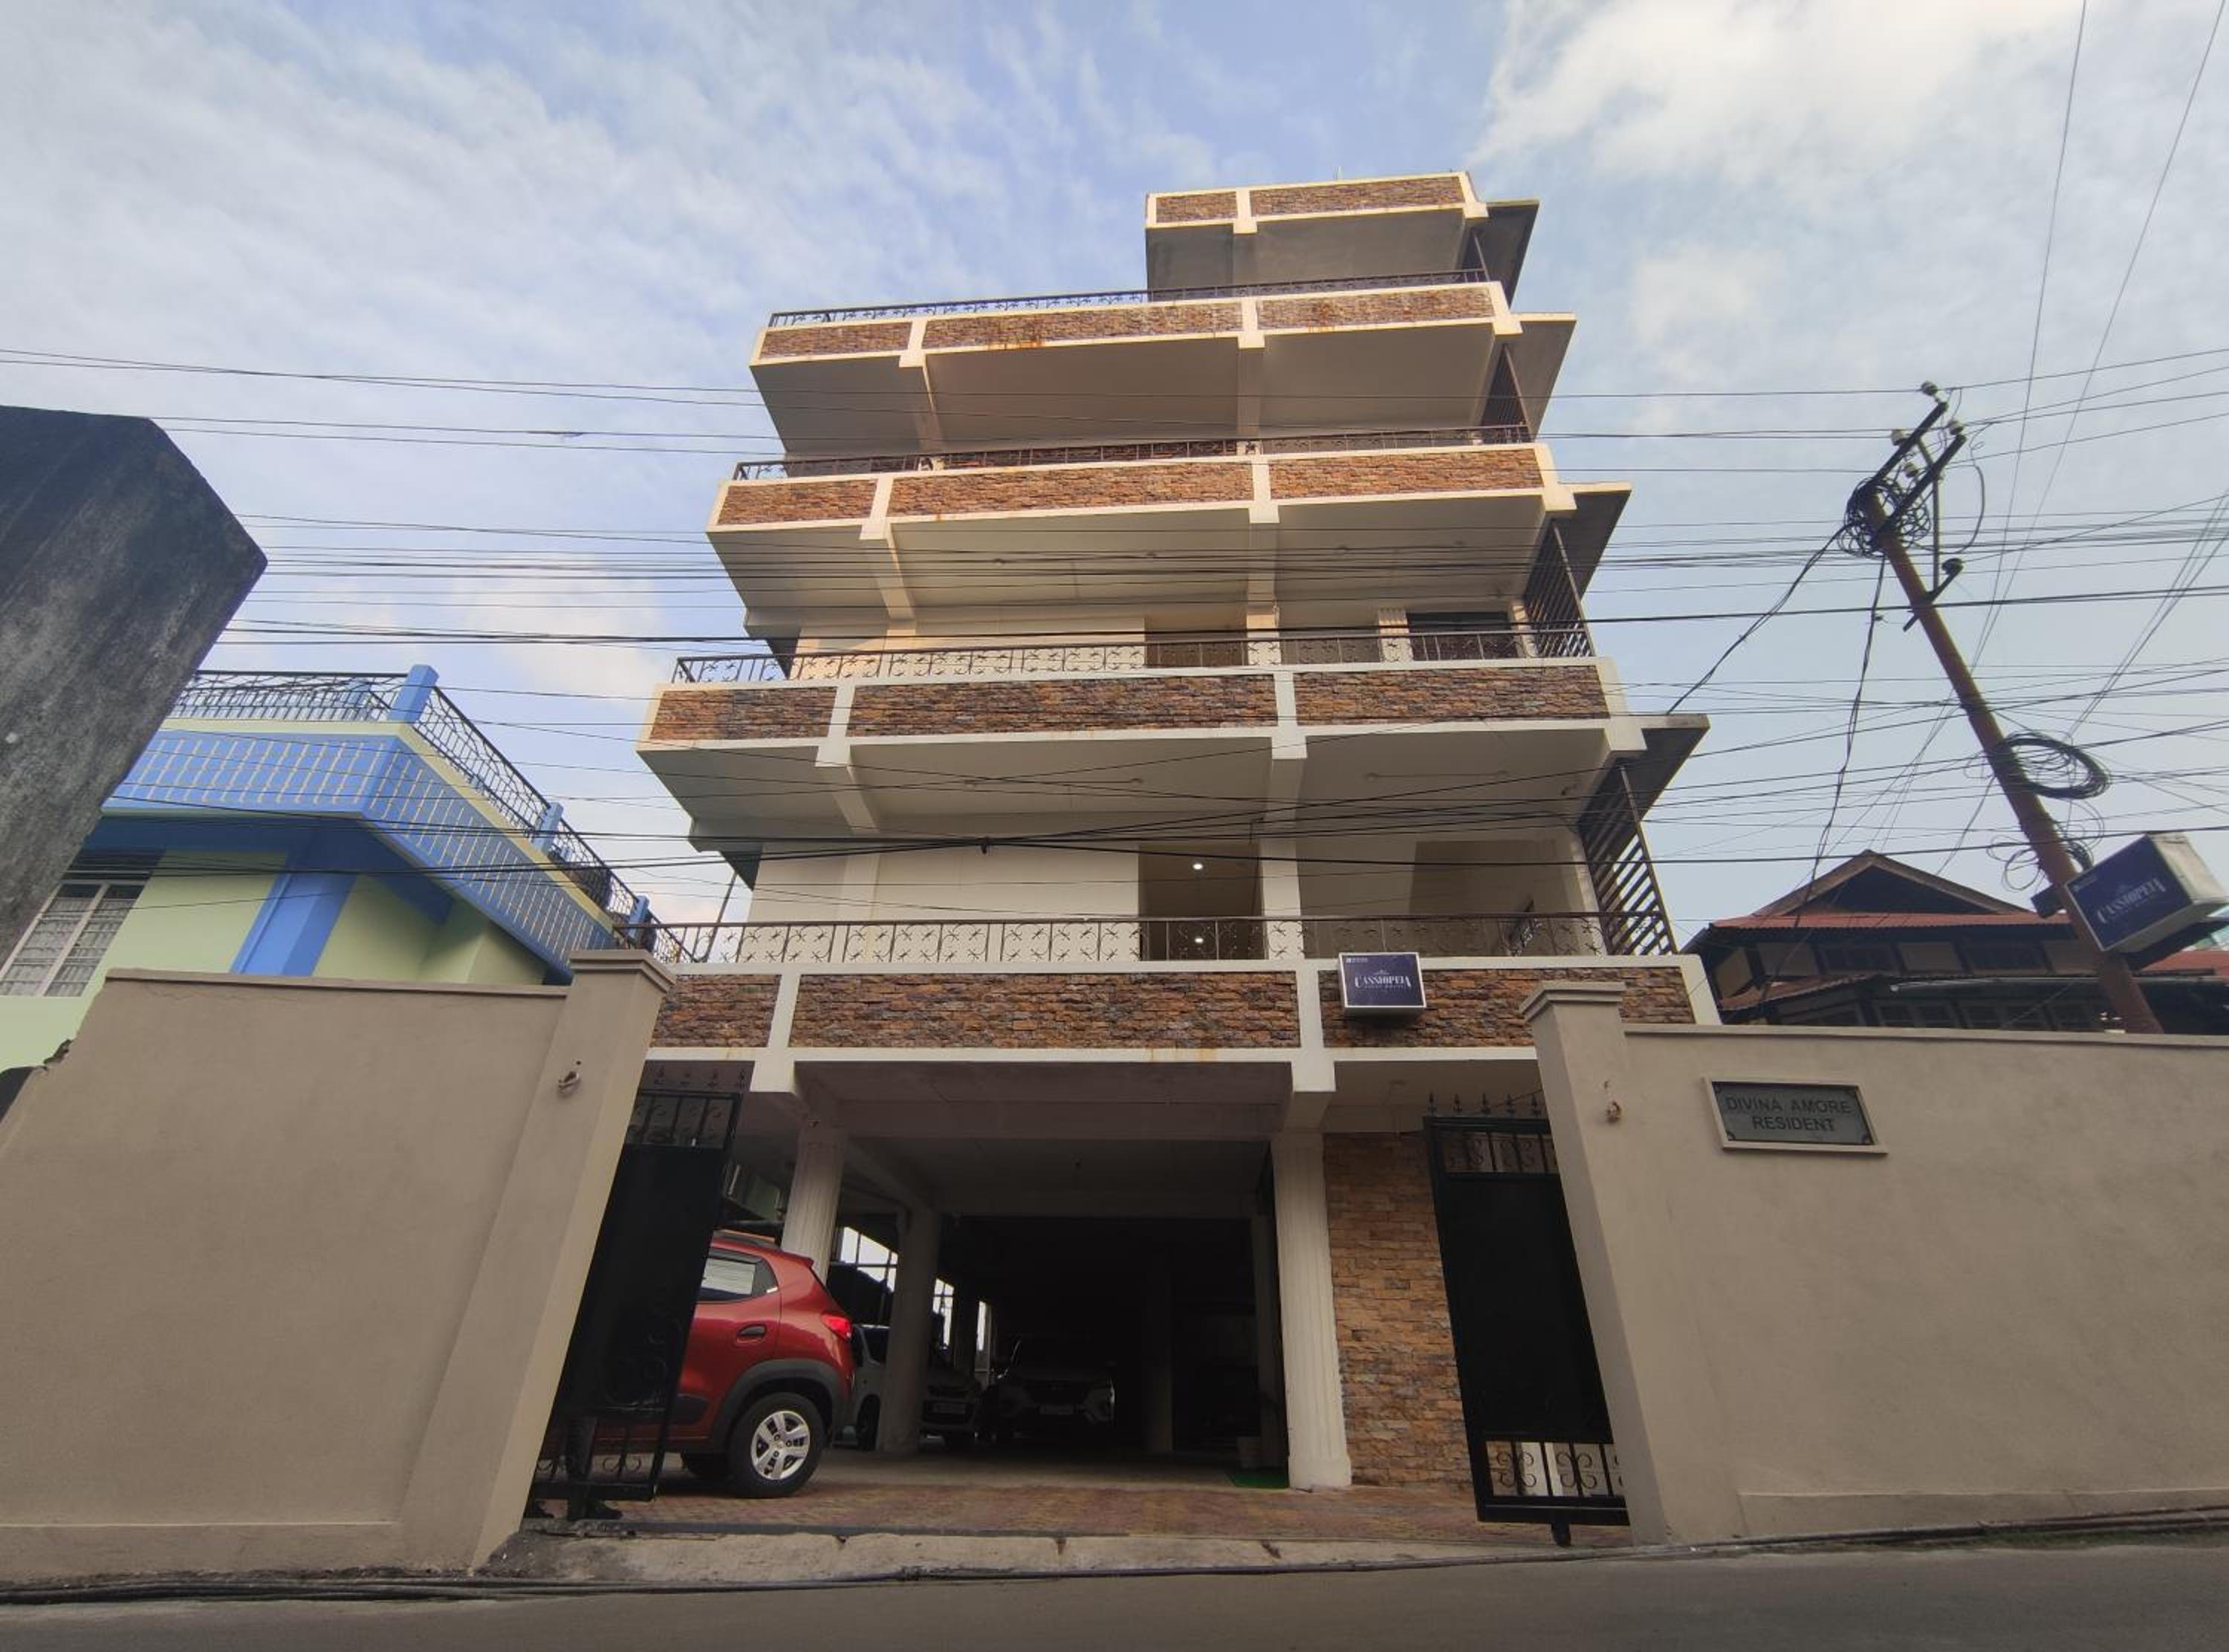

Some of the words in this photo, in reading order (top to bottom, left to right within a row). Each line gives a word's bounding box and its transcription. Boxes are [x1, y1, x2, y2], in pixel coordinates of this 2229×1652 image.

[1354, 975, 1412, 988] CASSIOPEIA
[1726, 1096, 1783, 1112] DIVINA
[1790, 1099, 1852, 1113] AMORE
[1751, 1116, 1836, 1131] RESIDENT
